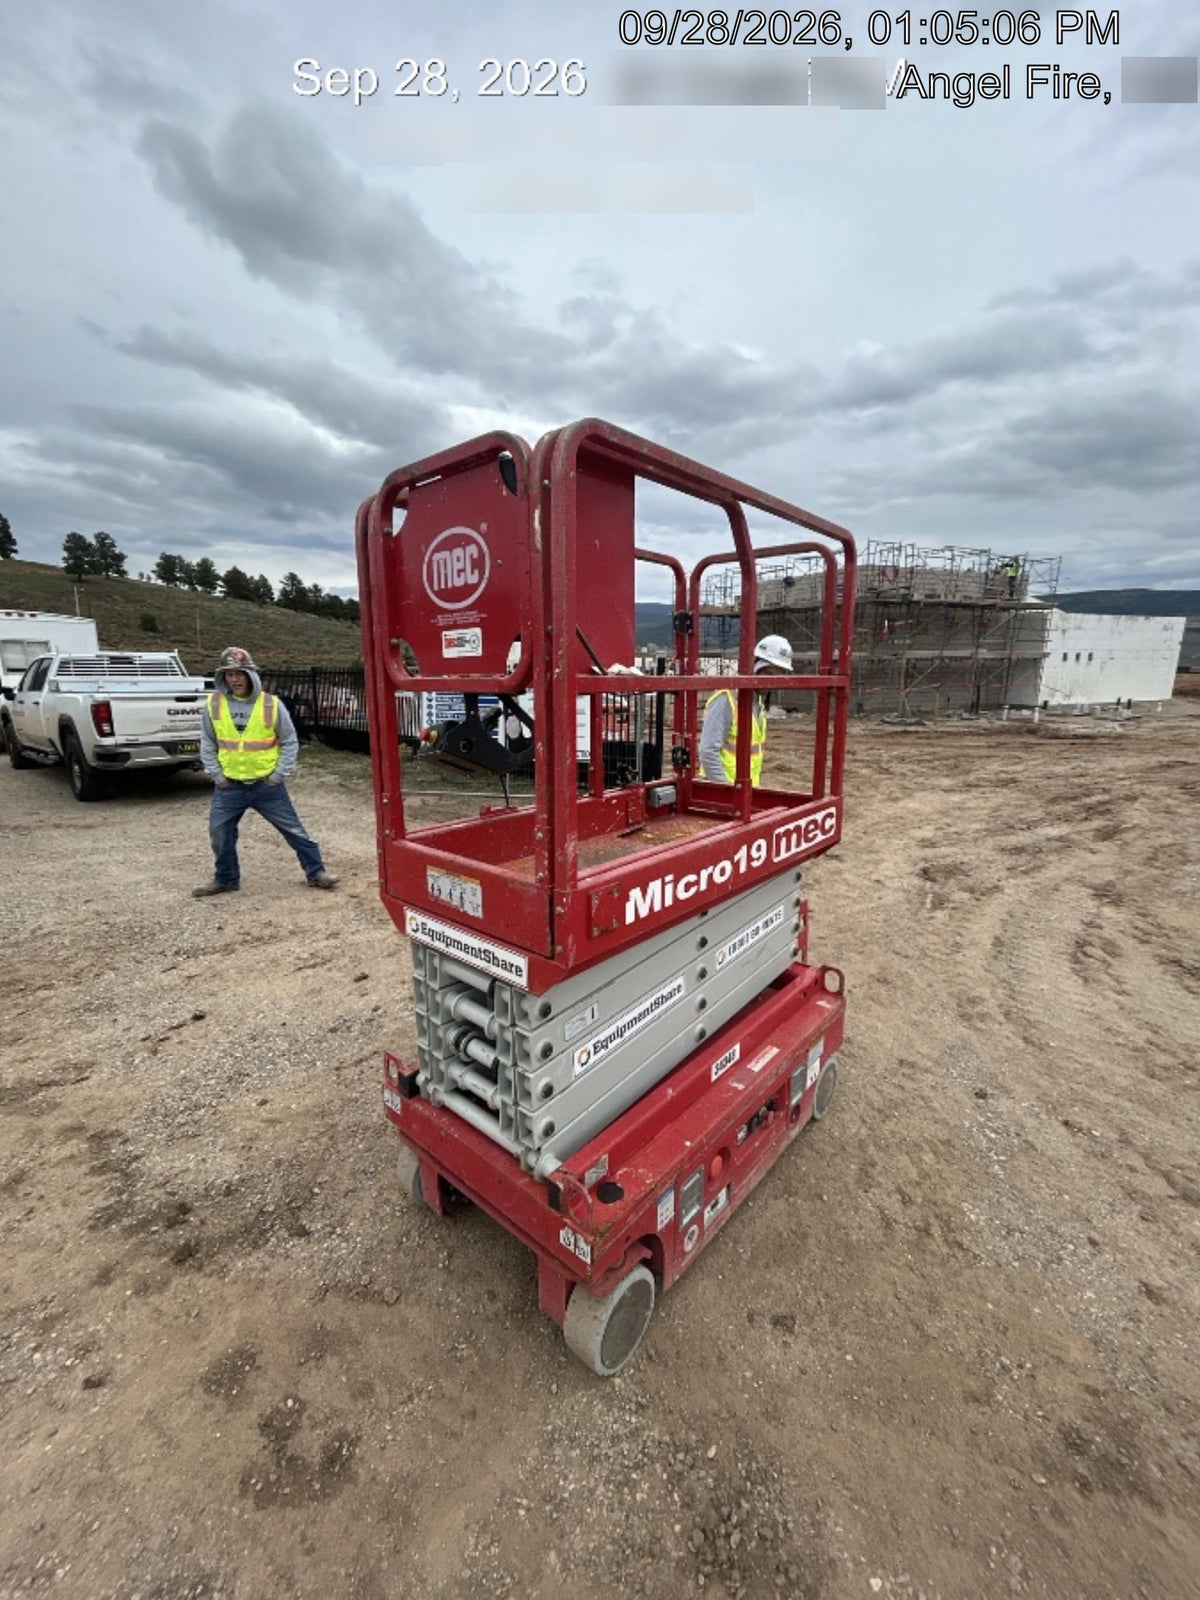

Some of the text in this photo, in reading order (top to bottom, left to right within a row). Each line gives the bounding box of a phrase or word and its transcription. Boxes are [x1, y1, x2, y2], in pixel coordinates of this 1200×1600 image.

[625, 838, 768, 926] Micro19
[420, 922, 523, 978] EquipmentShare
[593, 984, 682, 1056] EquipmentShare
